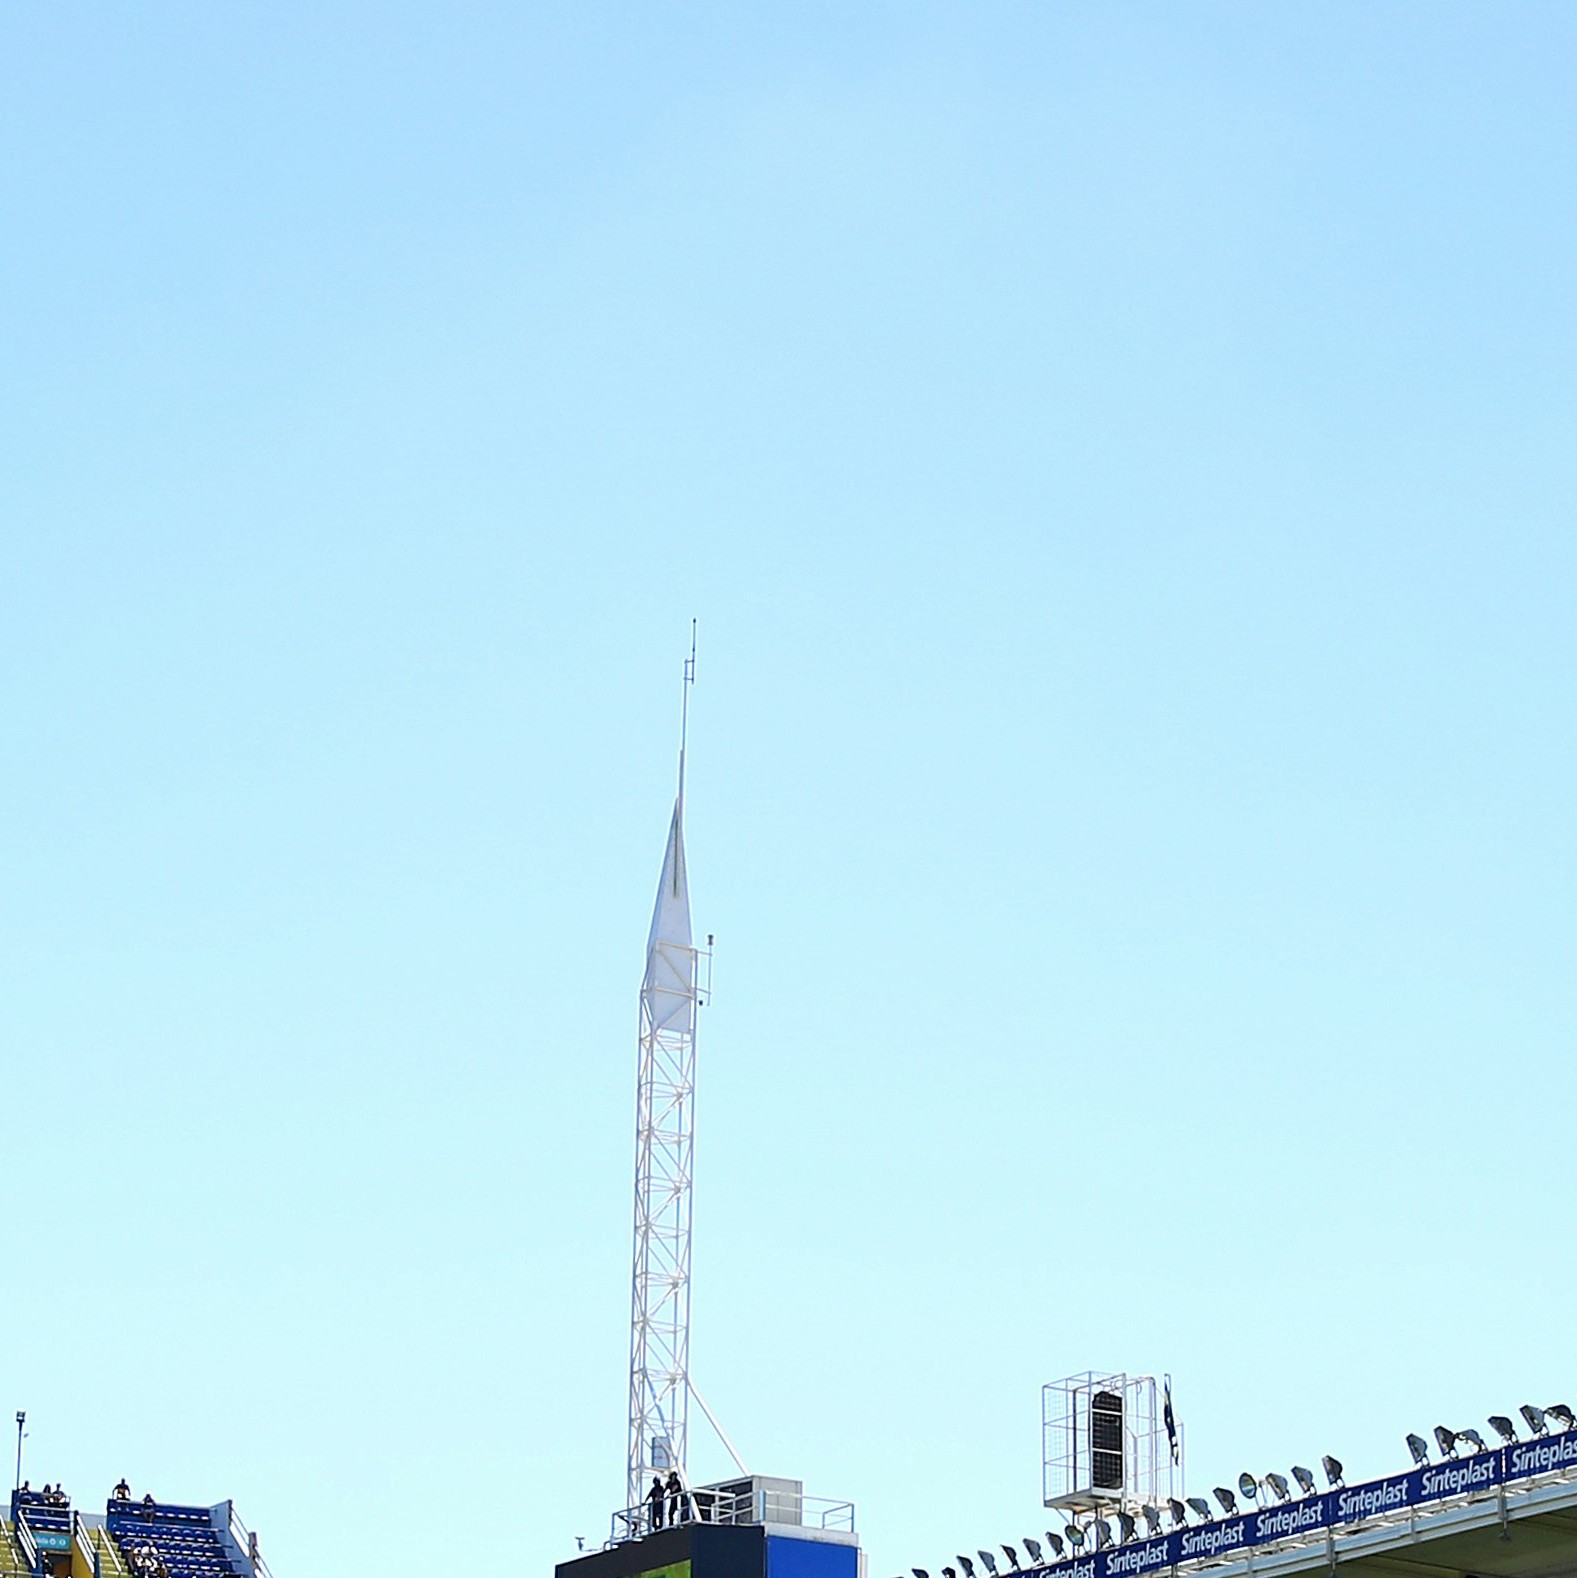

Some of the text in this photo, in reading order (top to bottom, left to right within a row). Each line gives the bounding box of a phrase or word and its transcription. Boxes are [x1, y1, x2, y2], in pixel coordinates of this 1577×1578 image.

[1420, 1455, 1496, 1496] Sinteplast
[1337, 1479, 1409, 1517] Sinteplast
[1255, 1503, 1323, 1538] Sinteplast
[1180, 1522, 1244, 1556] Sinteplast
[1105, 1541, 1169, 1575] Sinteplast
